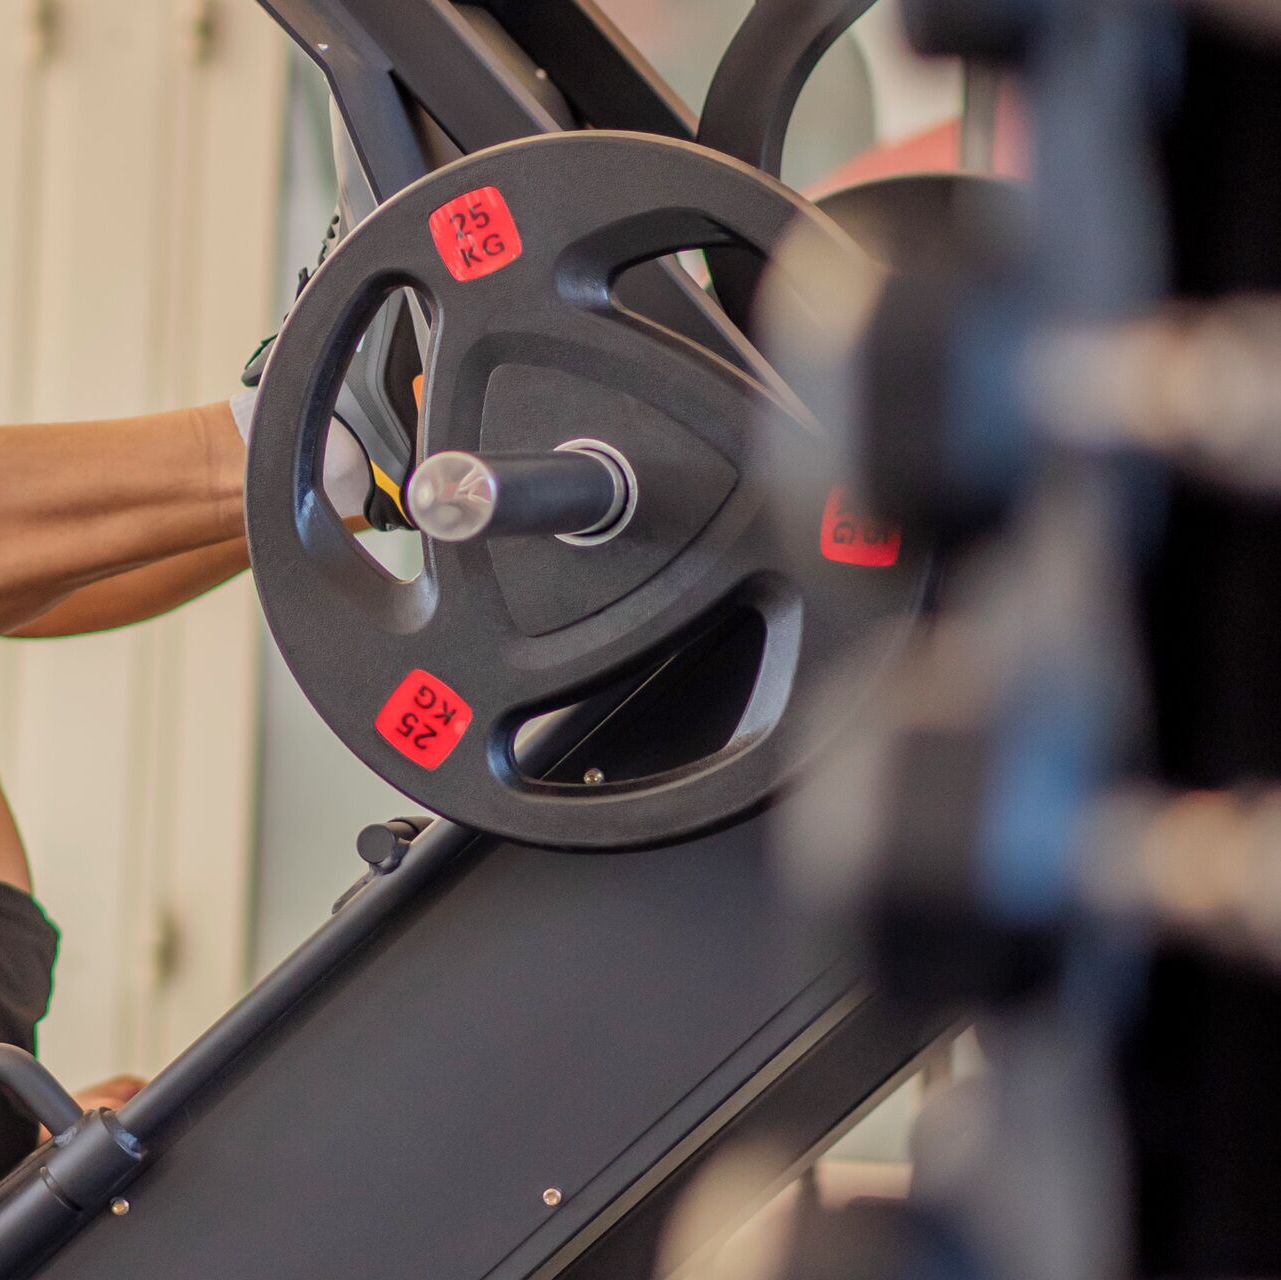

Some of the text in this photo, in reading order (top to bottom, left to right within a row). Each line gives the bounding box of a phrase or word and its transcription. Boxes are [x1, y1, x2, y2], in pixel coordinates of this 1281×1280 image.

[450, 202, 490, 240] 25
[460, 233, 505, 268] KG
[414, 685, 457, 727] KG
[396, 712, 437, 750] 25
